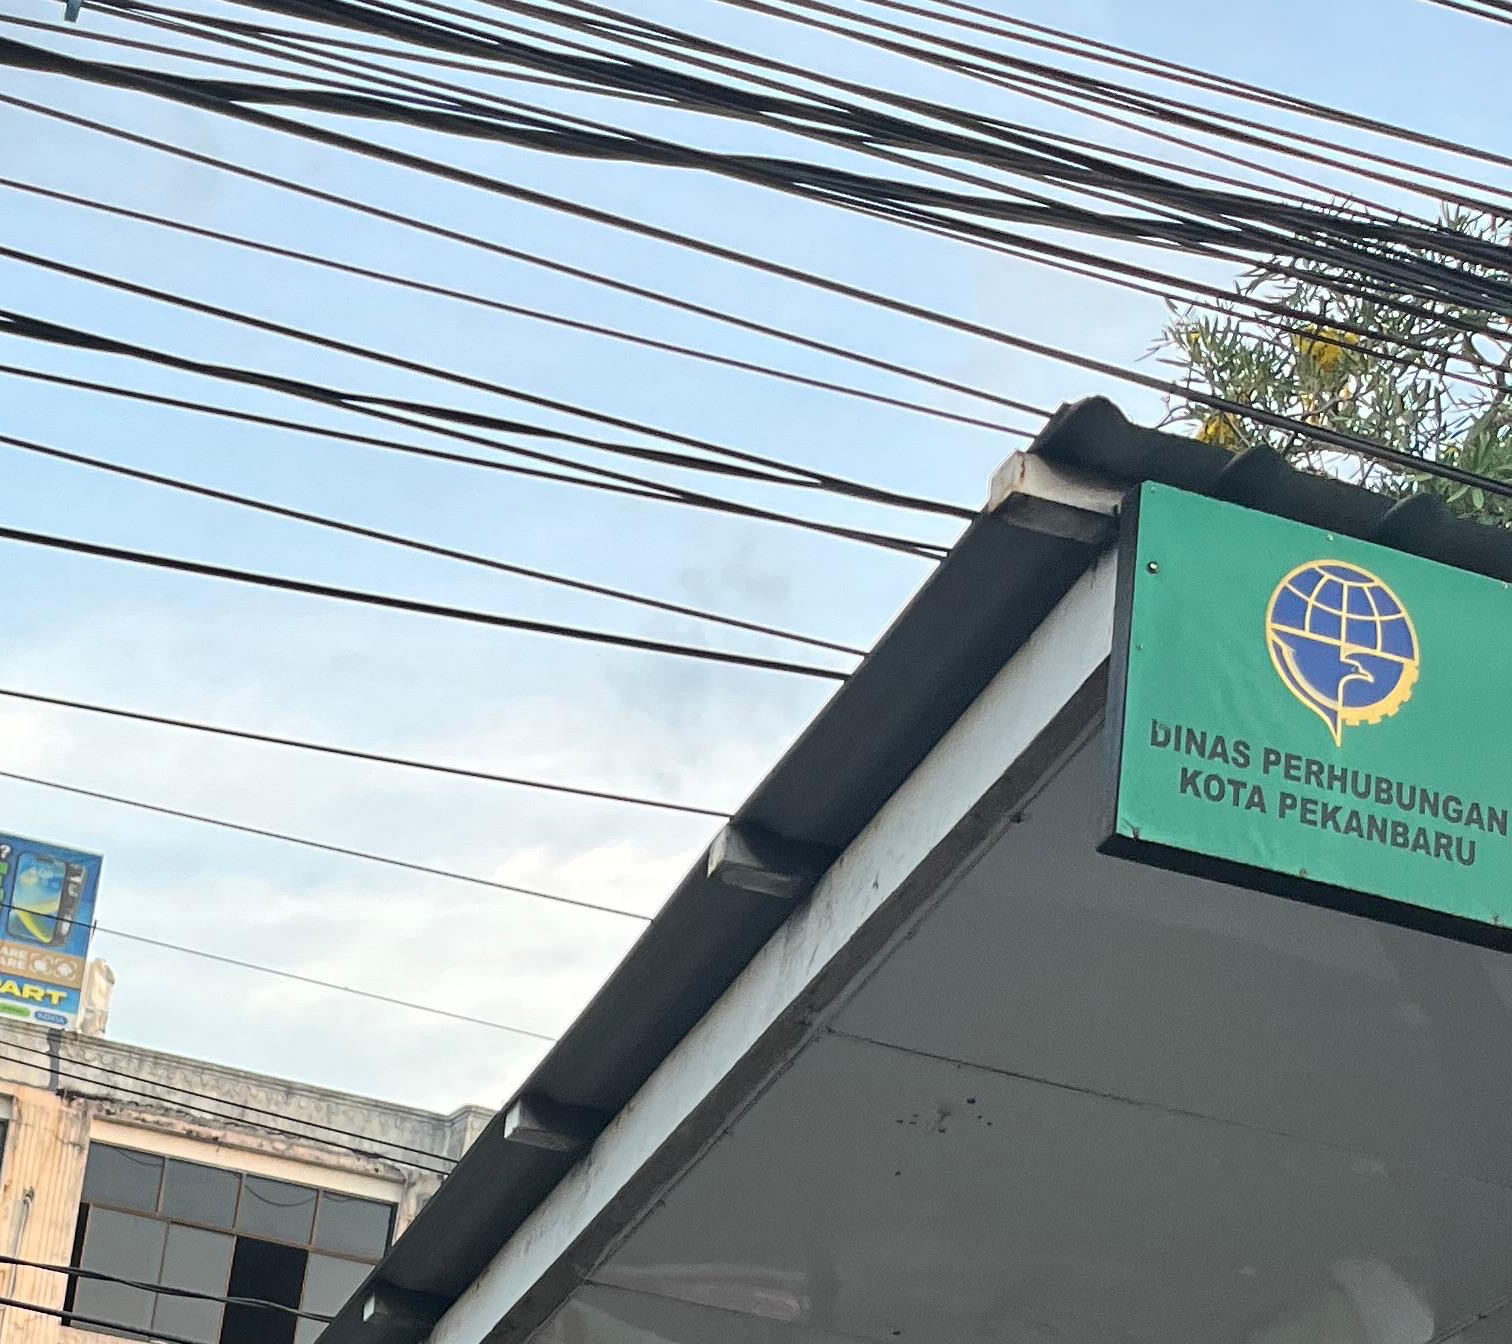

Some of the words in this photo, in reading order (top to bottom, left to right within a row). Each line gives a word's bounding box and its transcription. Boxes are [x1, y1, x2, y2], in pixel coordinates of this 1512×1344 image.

[1150, 718, 1251, 768] DINAS
[1263, 747, 1508, 835] PERHUBUNGAN
[1179, 767, 1267, 813] KOTA
[1278, 792, 1476, 865] PEKANBARU
